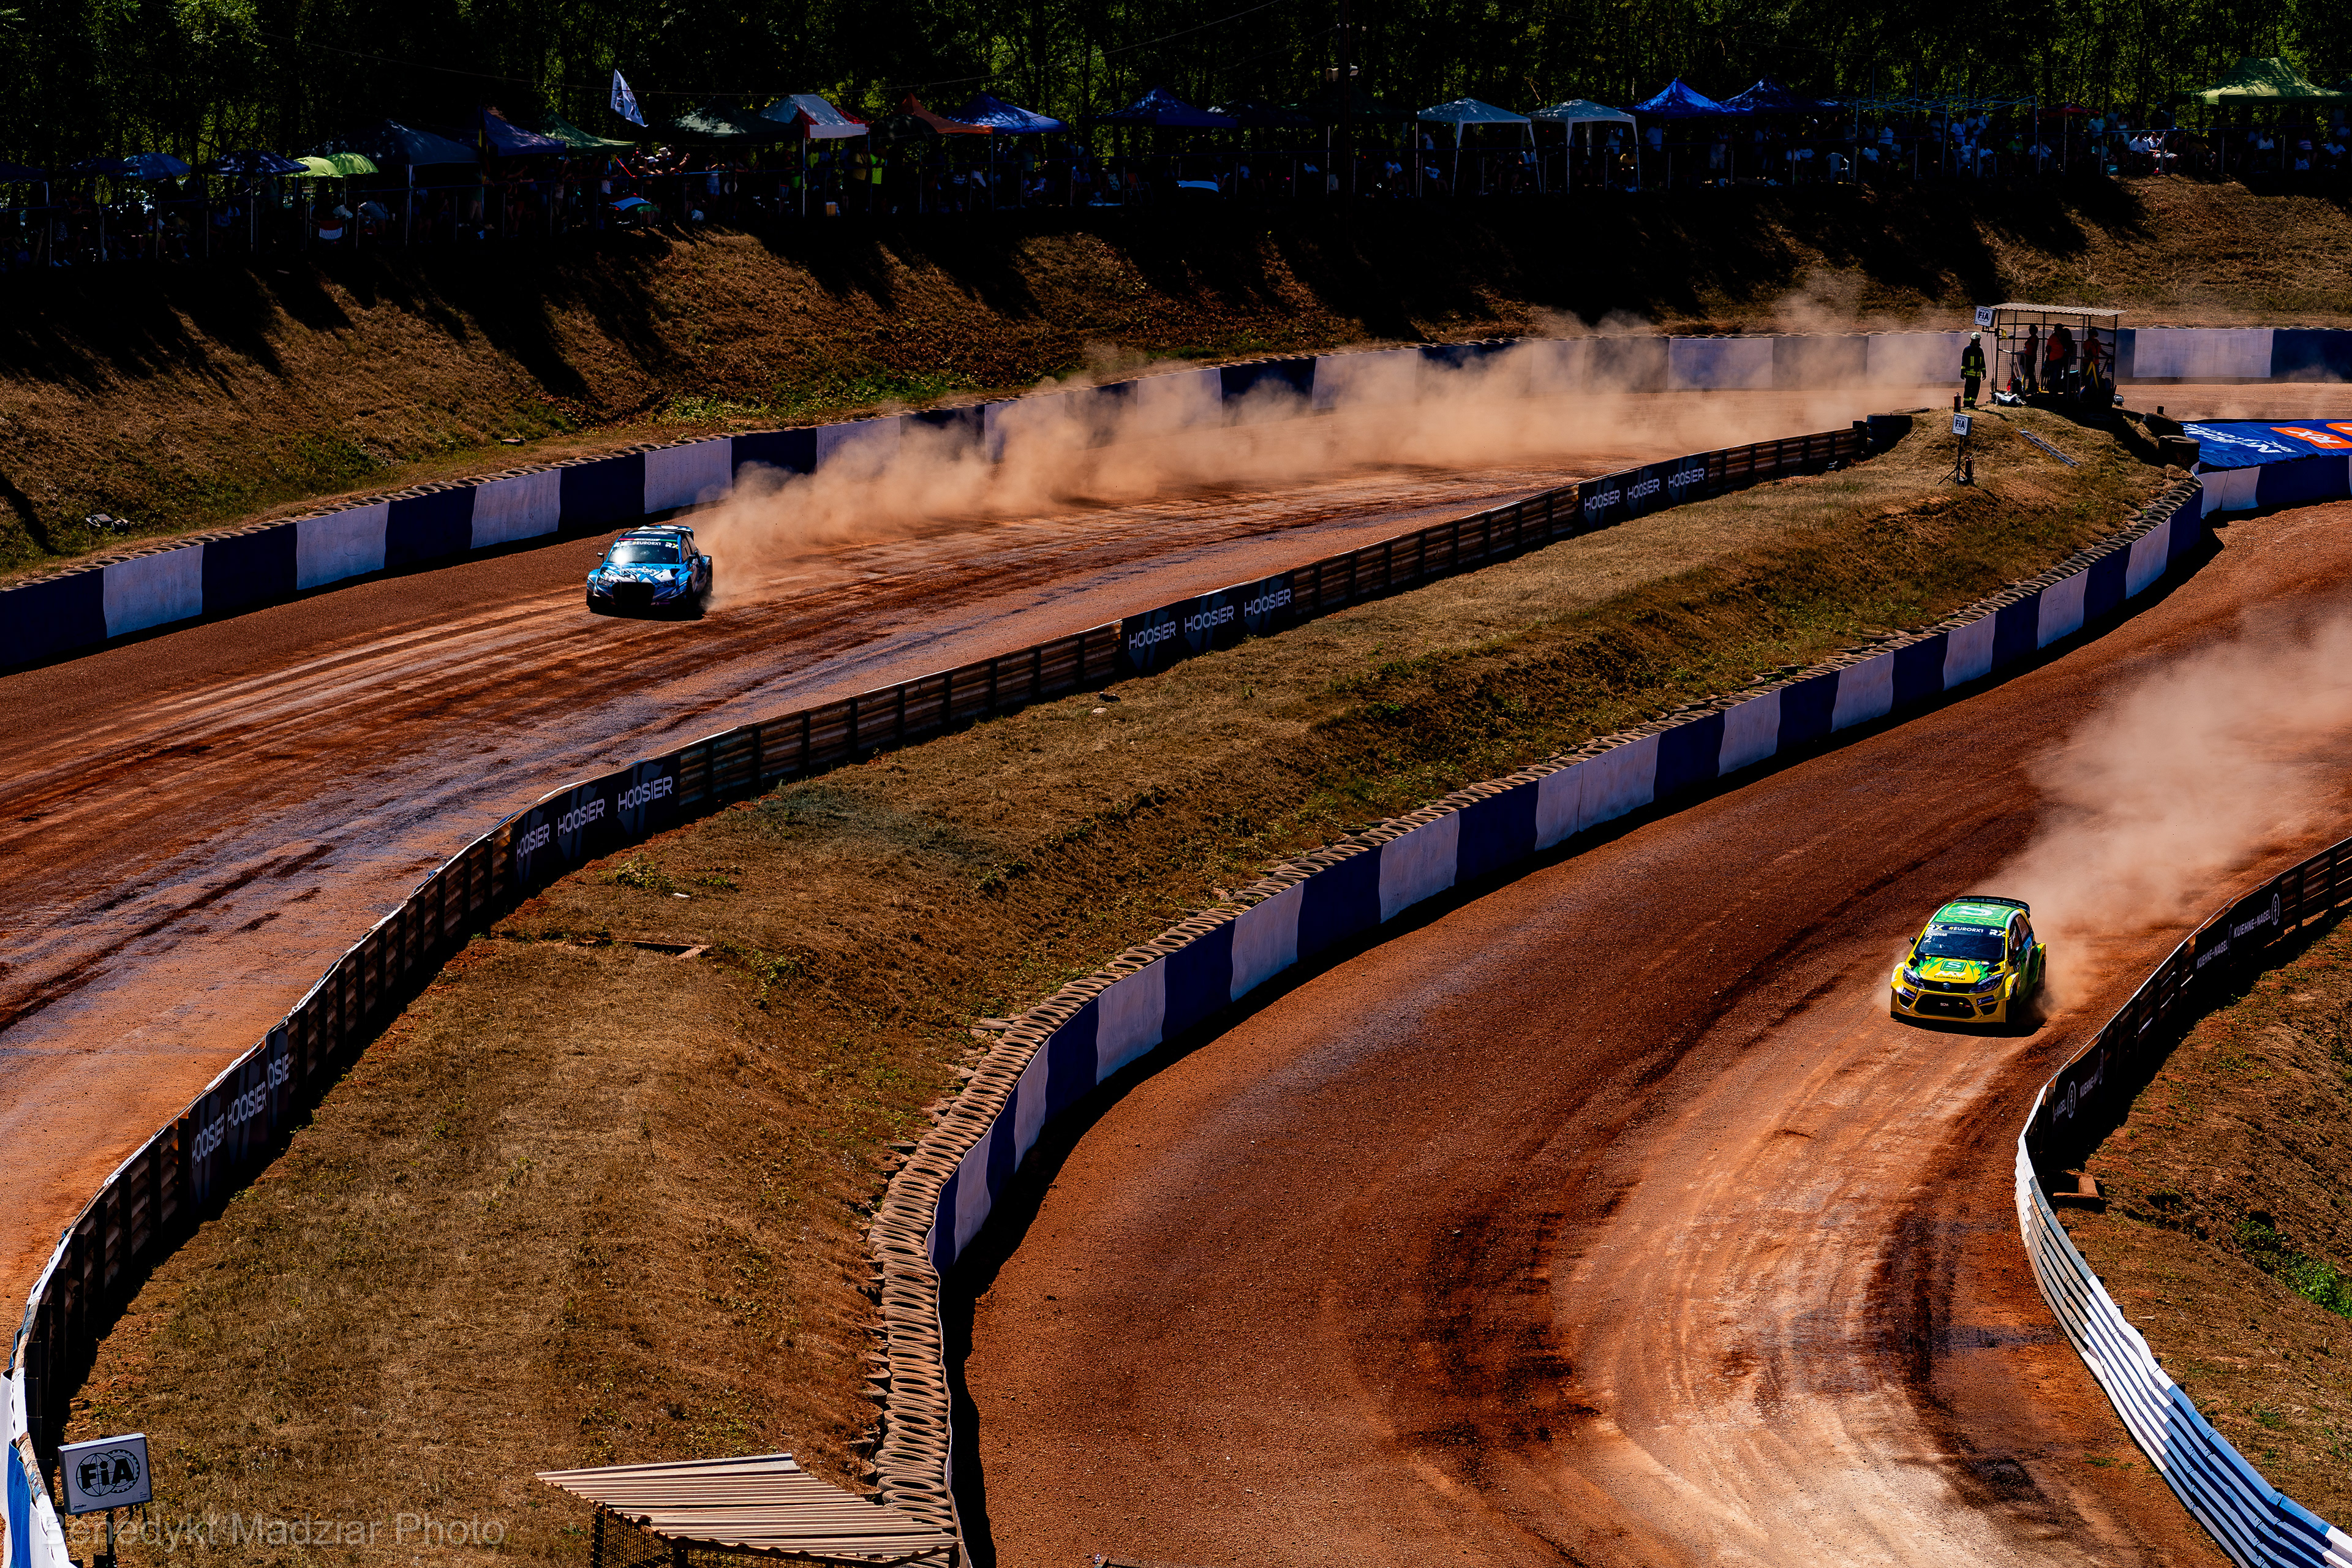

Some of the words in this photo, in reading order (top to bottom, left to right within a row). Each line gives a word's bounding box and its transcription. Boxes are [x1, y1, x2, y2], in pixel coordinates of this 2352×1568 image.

[1584, 489, 1620, 511] HOOSIER
[1627, 478, 1660, 500] HOOSIER
[1668, 467, 1705, 489] HOOSIER
[1129, 620, 1176, 650] HOOSIER
[1185, 605, 1234, 633] HOOSIER
[1244, 588, 1291, 617] HOOSIER
[516, 823, 550, 862] HOOSIER
[557, 798, 605, 837] HOOSIER
[617, 775, 673, 812] HOOSIER
[2196, 939, 2228, 969] KUEHNE+NAGEL
[2233, 909, 2271, 938] KUEHNE+NAGEL
[192, 1113, 225, 1169] HOOSIER
[227, 1081, 266, 1132] HOOSIER
[266, 1053, 289, 1092] OSIE
